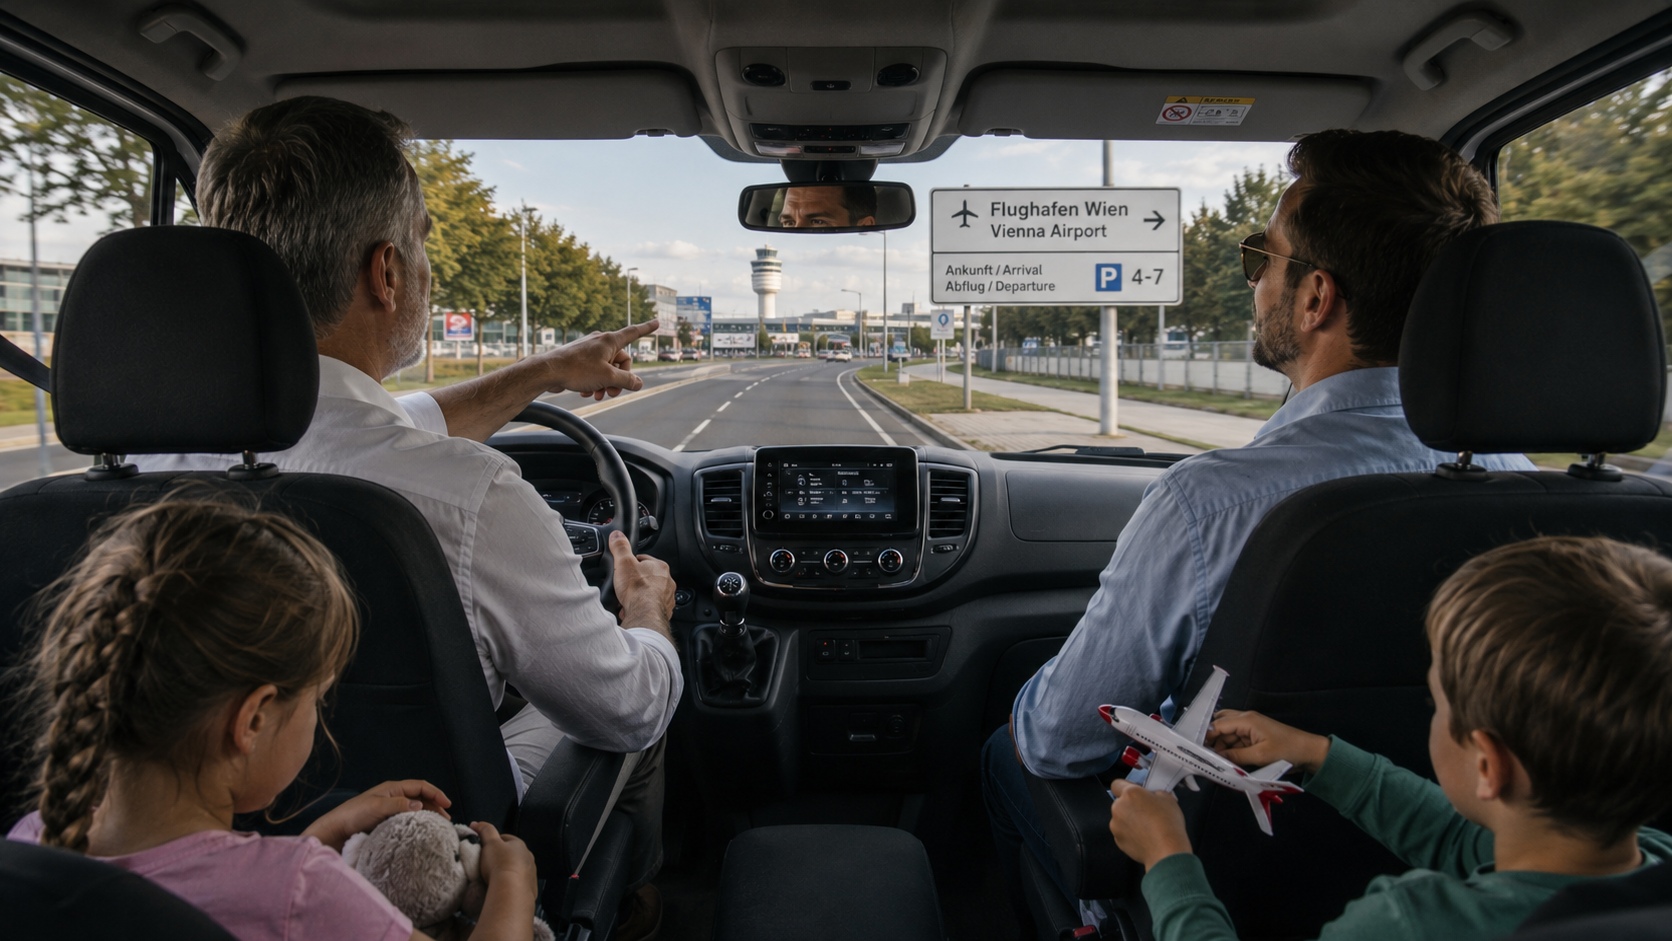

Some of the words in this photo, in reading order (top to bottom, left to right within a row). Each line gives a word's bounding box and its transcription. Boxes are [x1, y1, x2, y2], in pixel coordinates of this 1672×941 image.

[991, 201, 1078, 220] Flughafen
[1085, 201, 1128, 216] Wien
[991, 224, 1045, 238] Vienna
[1050, 224, 1106, 241] Airport
[946, 265, 993, 275] Ankunft
[1003, 265, 1042, 275] Arrival
[1100, 267, 1117, 289] P
[1132, 269, 1163, 284] 4-7
[945, 281, 985, 294] Abflug
[996, 281, 1055, 294] Departure
